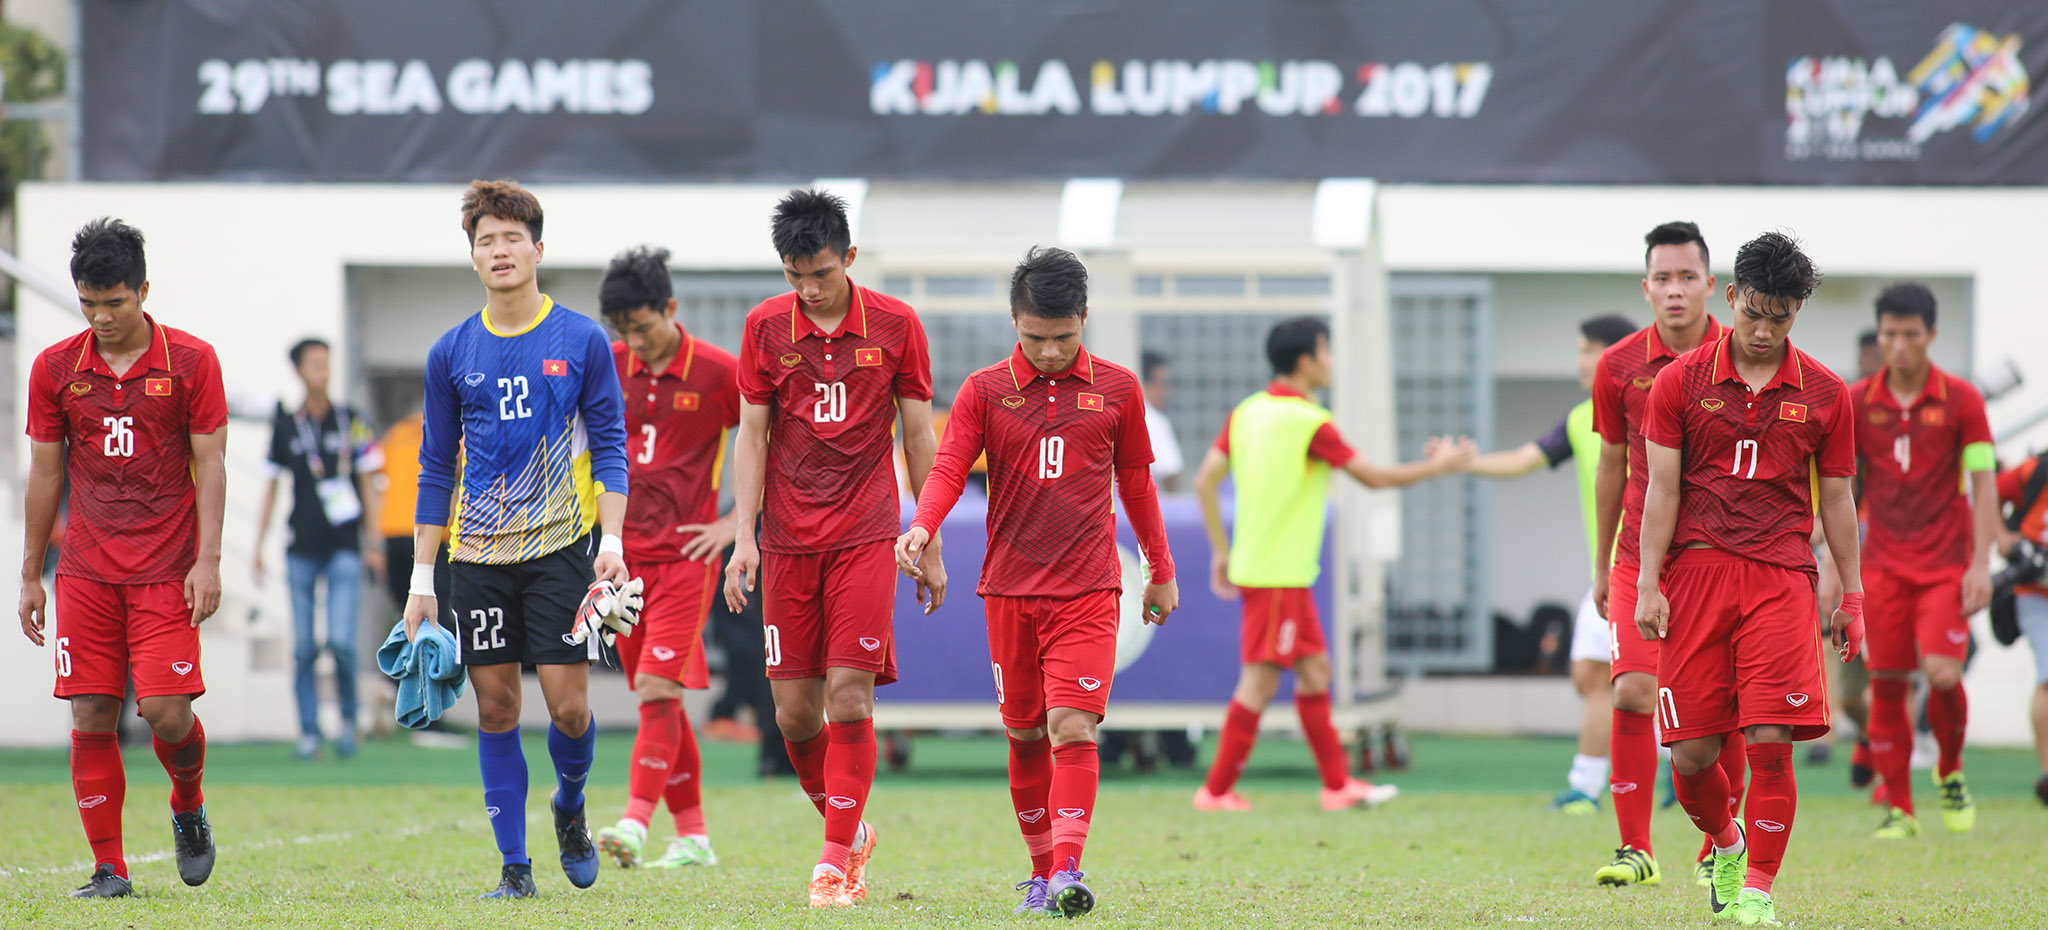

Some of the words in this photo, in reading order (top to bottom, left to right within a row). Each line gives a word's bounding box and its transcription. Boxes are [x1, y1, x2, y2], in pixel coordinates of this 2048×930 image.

[198, 59, 321, 115] 29TH
[325, 59, 442, 115] SEA
[446, 58, 655, 115] GAMES
[870, 58, 1081, 116] KUALA
[1090, 58, 1343, 117] LUMPUR
[1354, 60, 1494, 118] 2017
[497, 375, 532, 420] 22
[814, 381, 847, 422] 20
[103, 416, 134, 457] 26
[637, 423, 657, 464] 3
[1039, 435, 1064, 479] 19
[1731, 439, 1758, 479] 17
[470, 607, 506, 650] 22
[1609, 622, 1620, 665] 4
[992, 661, 1005, 704] 9
[1659, 687, 1680, 729] 17
